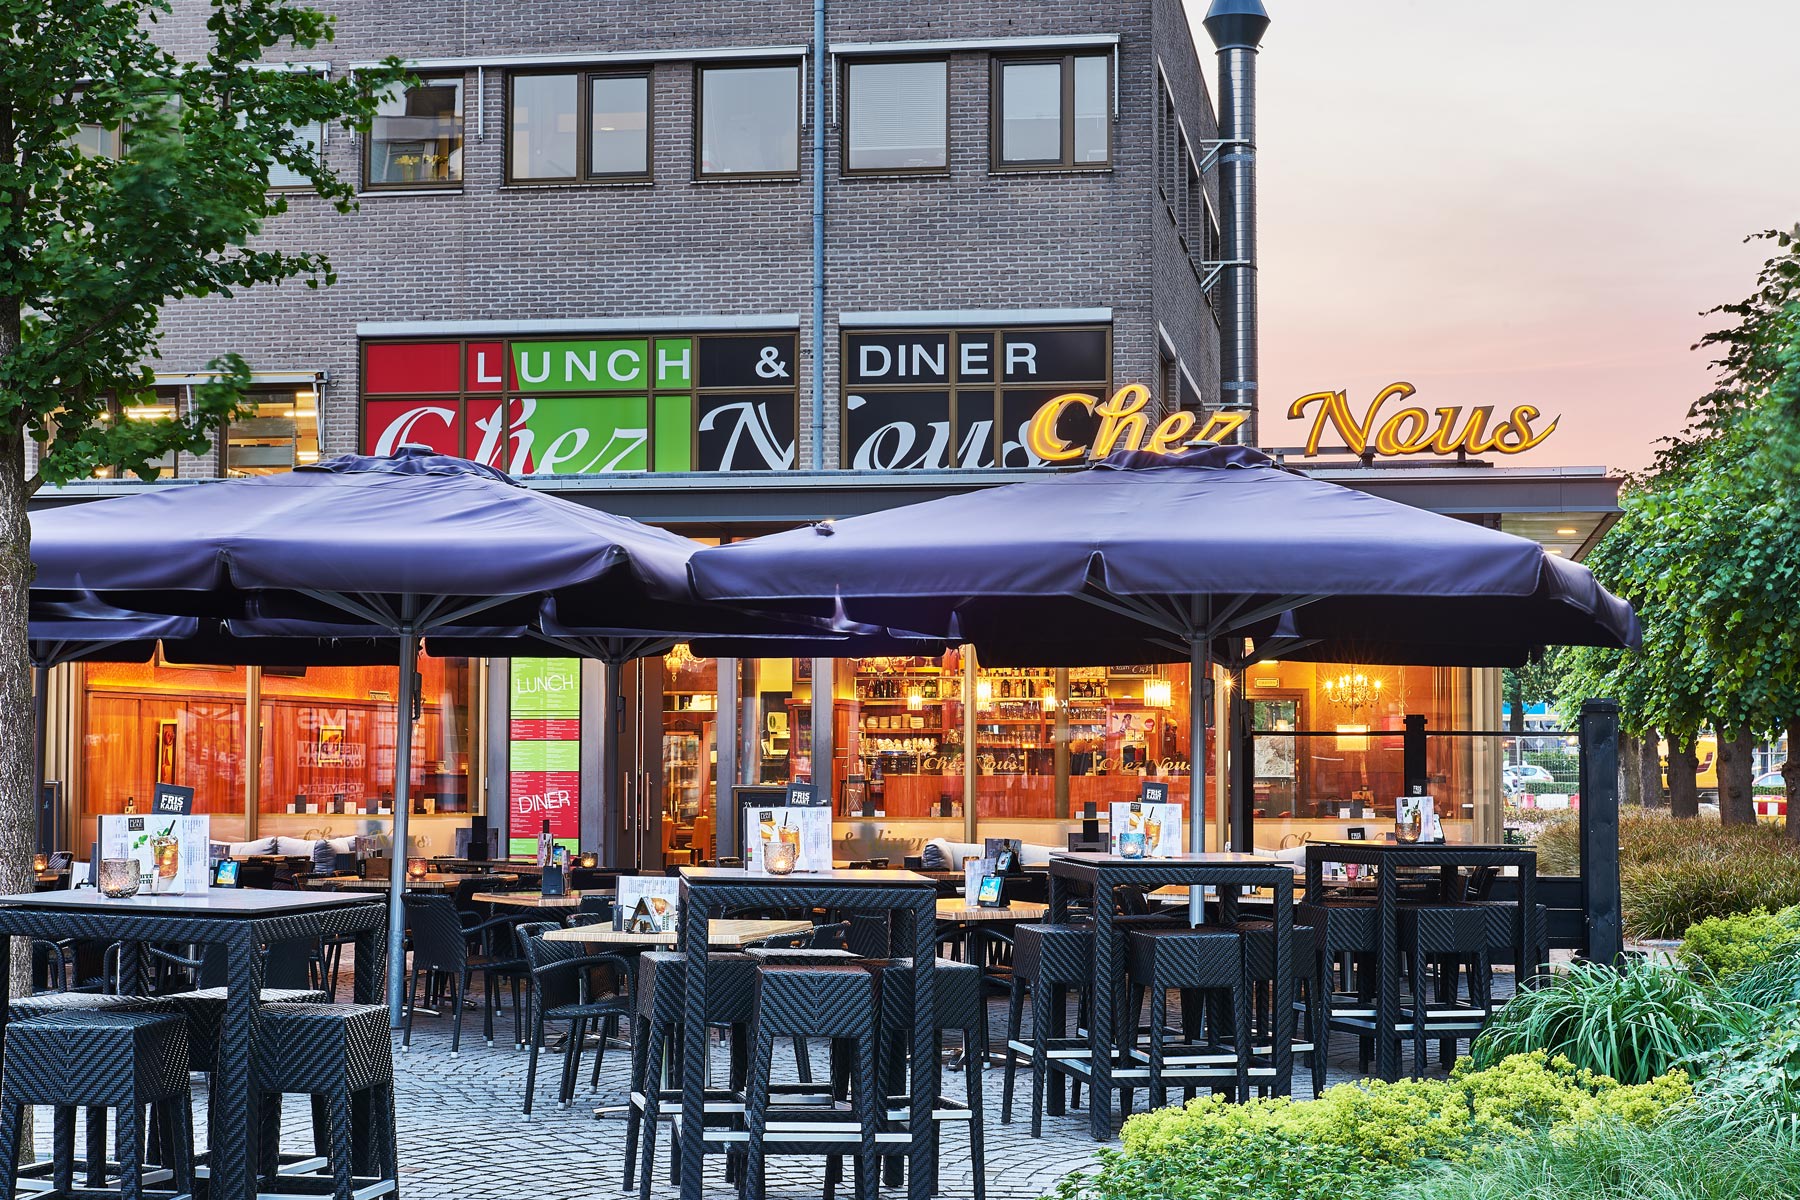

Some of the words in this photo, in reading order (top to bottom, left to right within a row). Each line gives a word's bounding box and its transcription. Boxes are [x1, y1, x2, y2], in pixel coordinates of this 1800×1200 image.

[476, 348, 690, 383] LUNCH
[754, 346, 790, 379] &
[859, 342, 1037, 377] DINER
[1026, 383, 1251, 461] Chez
[1286, 381, 1562, 458] Nous
[374, 398, 648, 474] Chez
[516, 674, 574, 694] LUNCH
[923, 757, 965, 770] Chez
[1100, 758, 1143, 771] Chez
[161, 794, 184, 806] FRIS
[518, 790, 571, 814] DINER
[792, 791, 810, 800] FRIS
[160, 802, 183, 812] KAART
[839, 831, 856, 851] &
